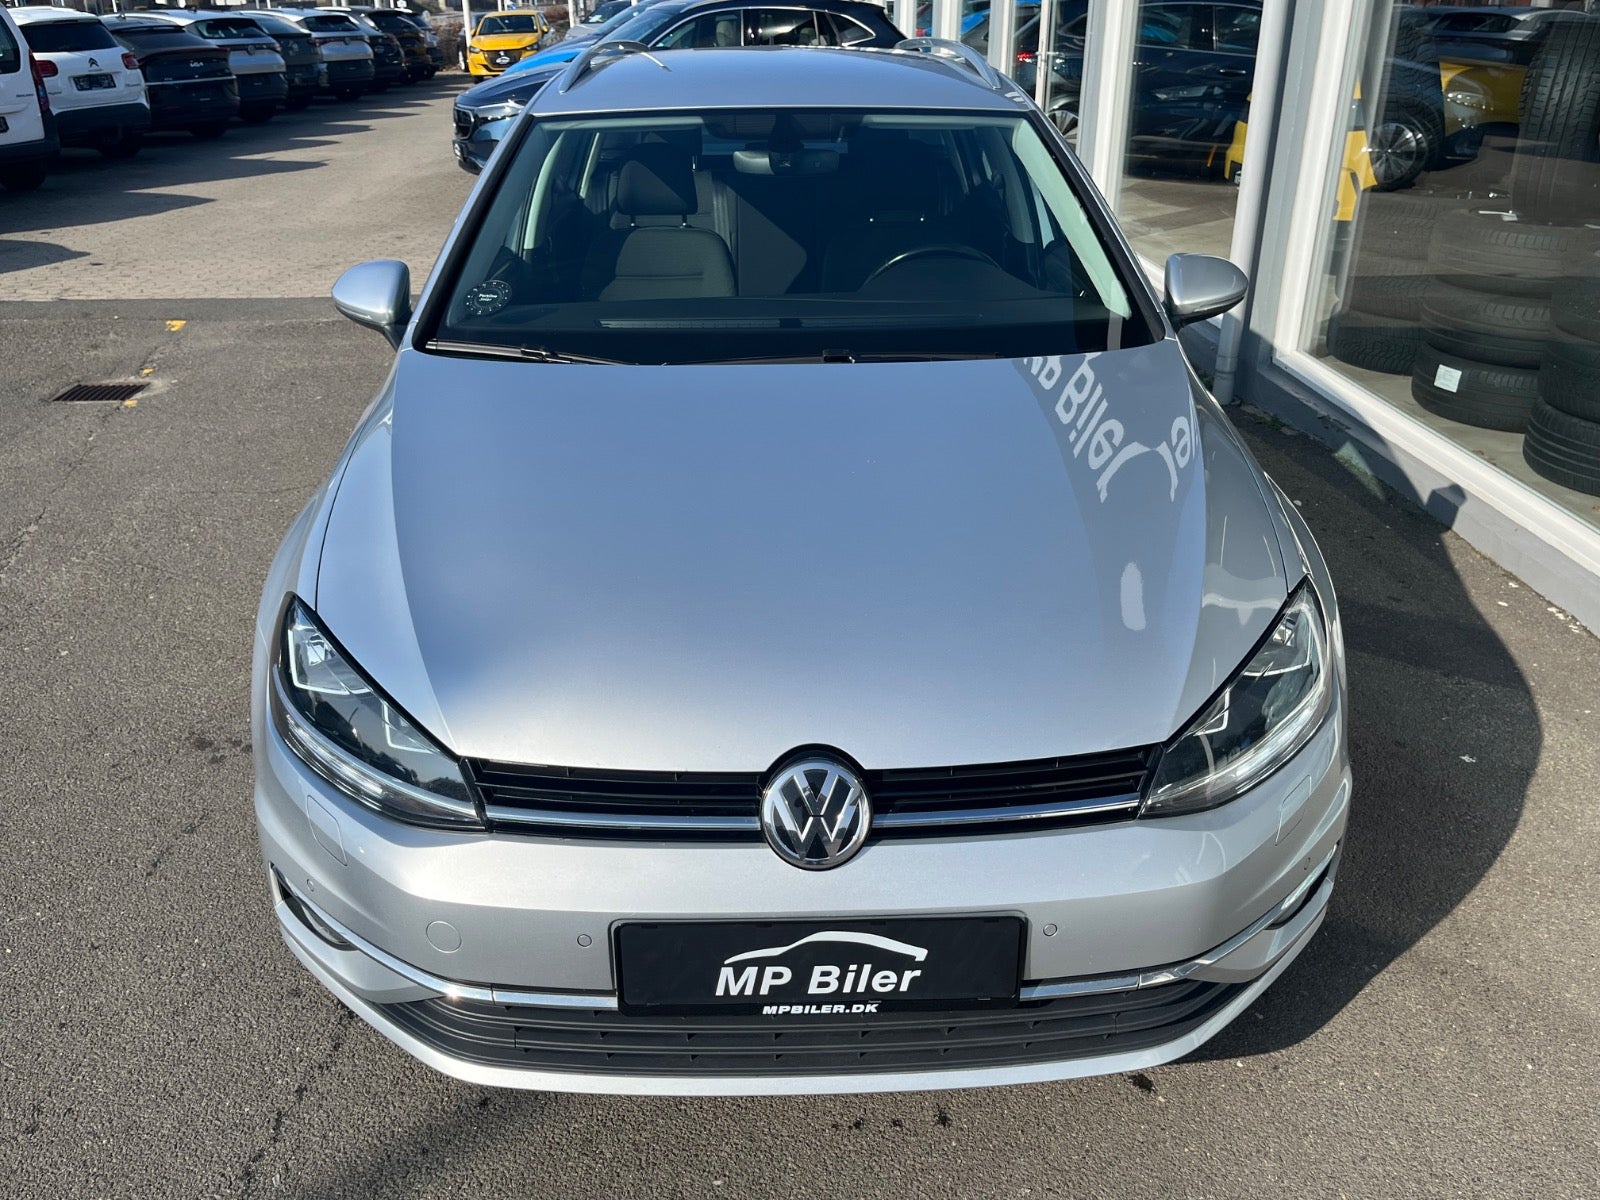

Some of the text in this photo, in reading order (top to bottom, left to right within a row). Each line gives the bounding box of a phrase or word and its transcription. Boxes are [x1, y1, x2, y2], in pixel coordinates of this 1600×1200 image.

[715, 963, 922, 996] MP Biler
[762, 1003, 879, 1014] MPBILER.DK
